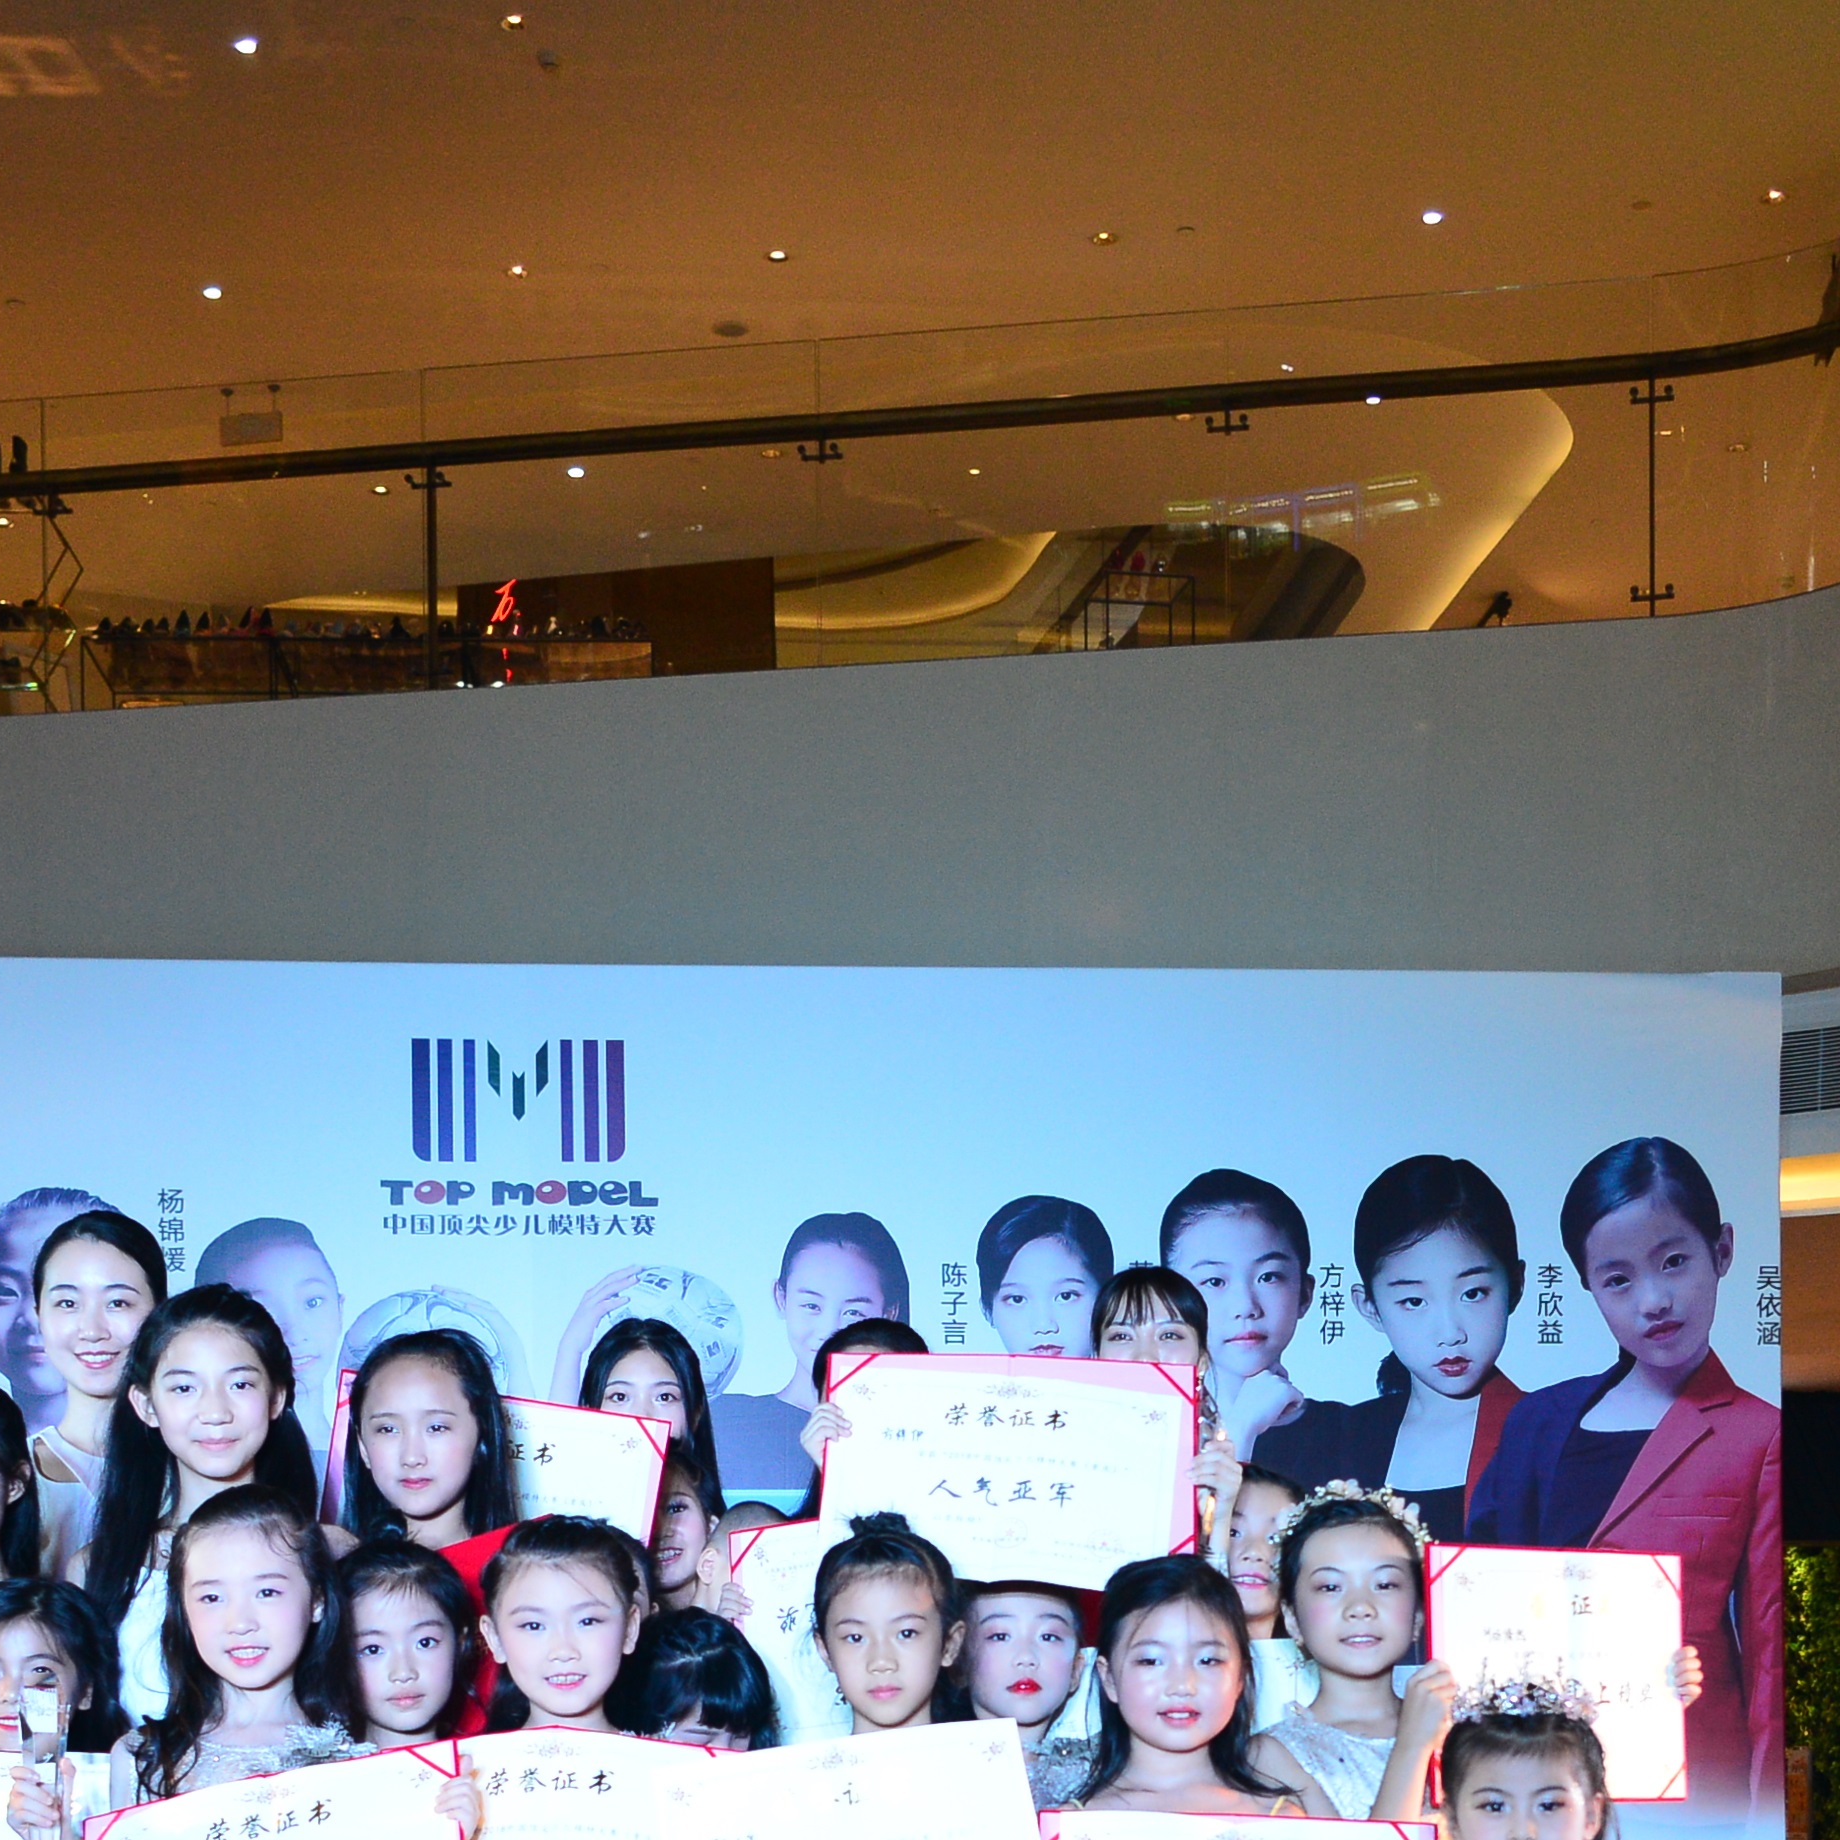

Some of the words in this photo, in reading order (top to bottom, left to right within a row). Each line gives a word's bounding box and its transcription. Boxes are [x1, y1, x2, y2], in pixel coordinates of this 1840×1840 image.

[383, 1214, 656, 1236] 中国顶尖少儿模特大赛
[941, 1262, 967, 1345] 陈子言
[1319, 1263, 1346, 1345] 方梓伊
[1537, 1263, 1563, 1345] 李欣益
[1756, 1265, 1781, 1346] 吴依涵
[944, 1404, 1069, 1430] 荣誉证书
[928, 1476, 1076, 1508] 人气亚军
[484, 1767, 615, 1797] 荣誉证书
